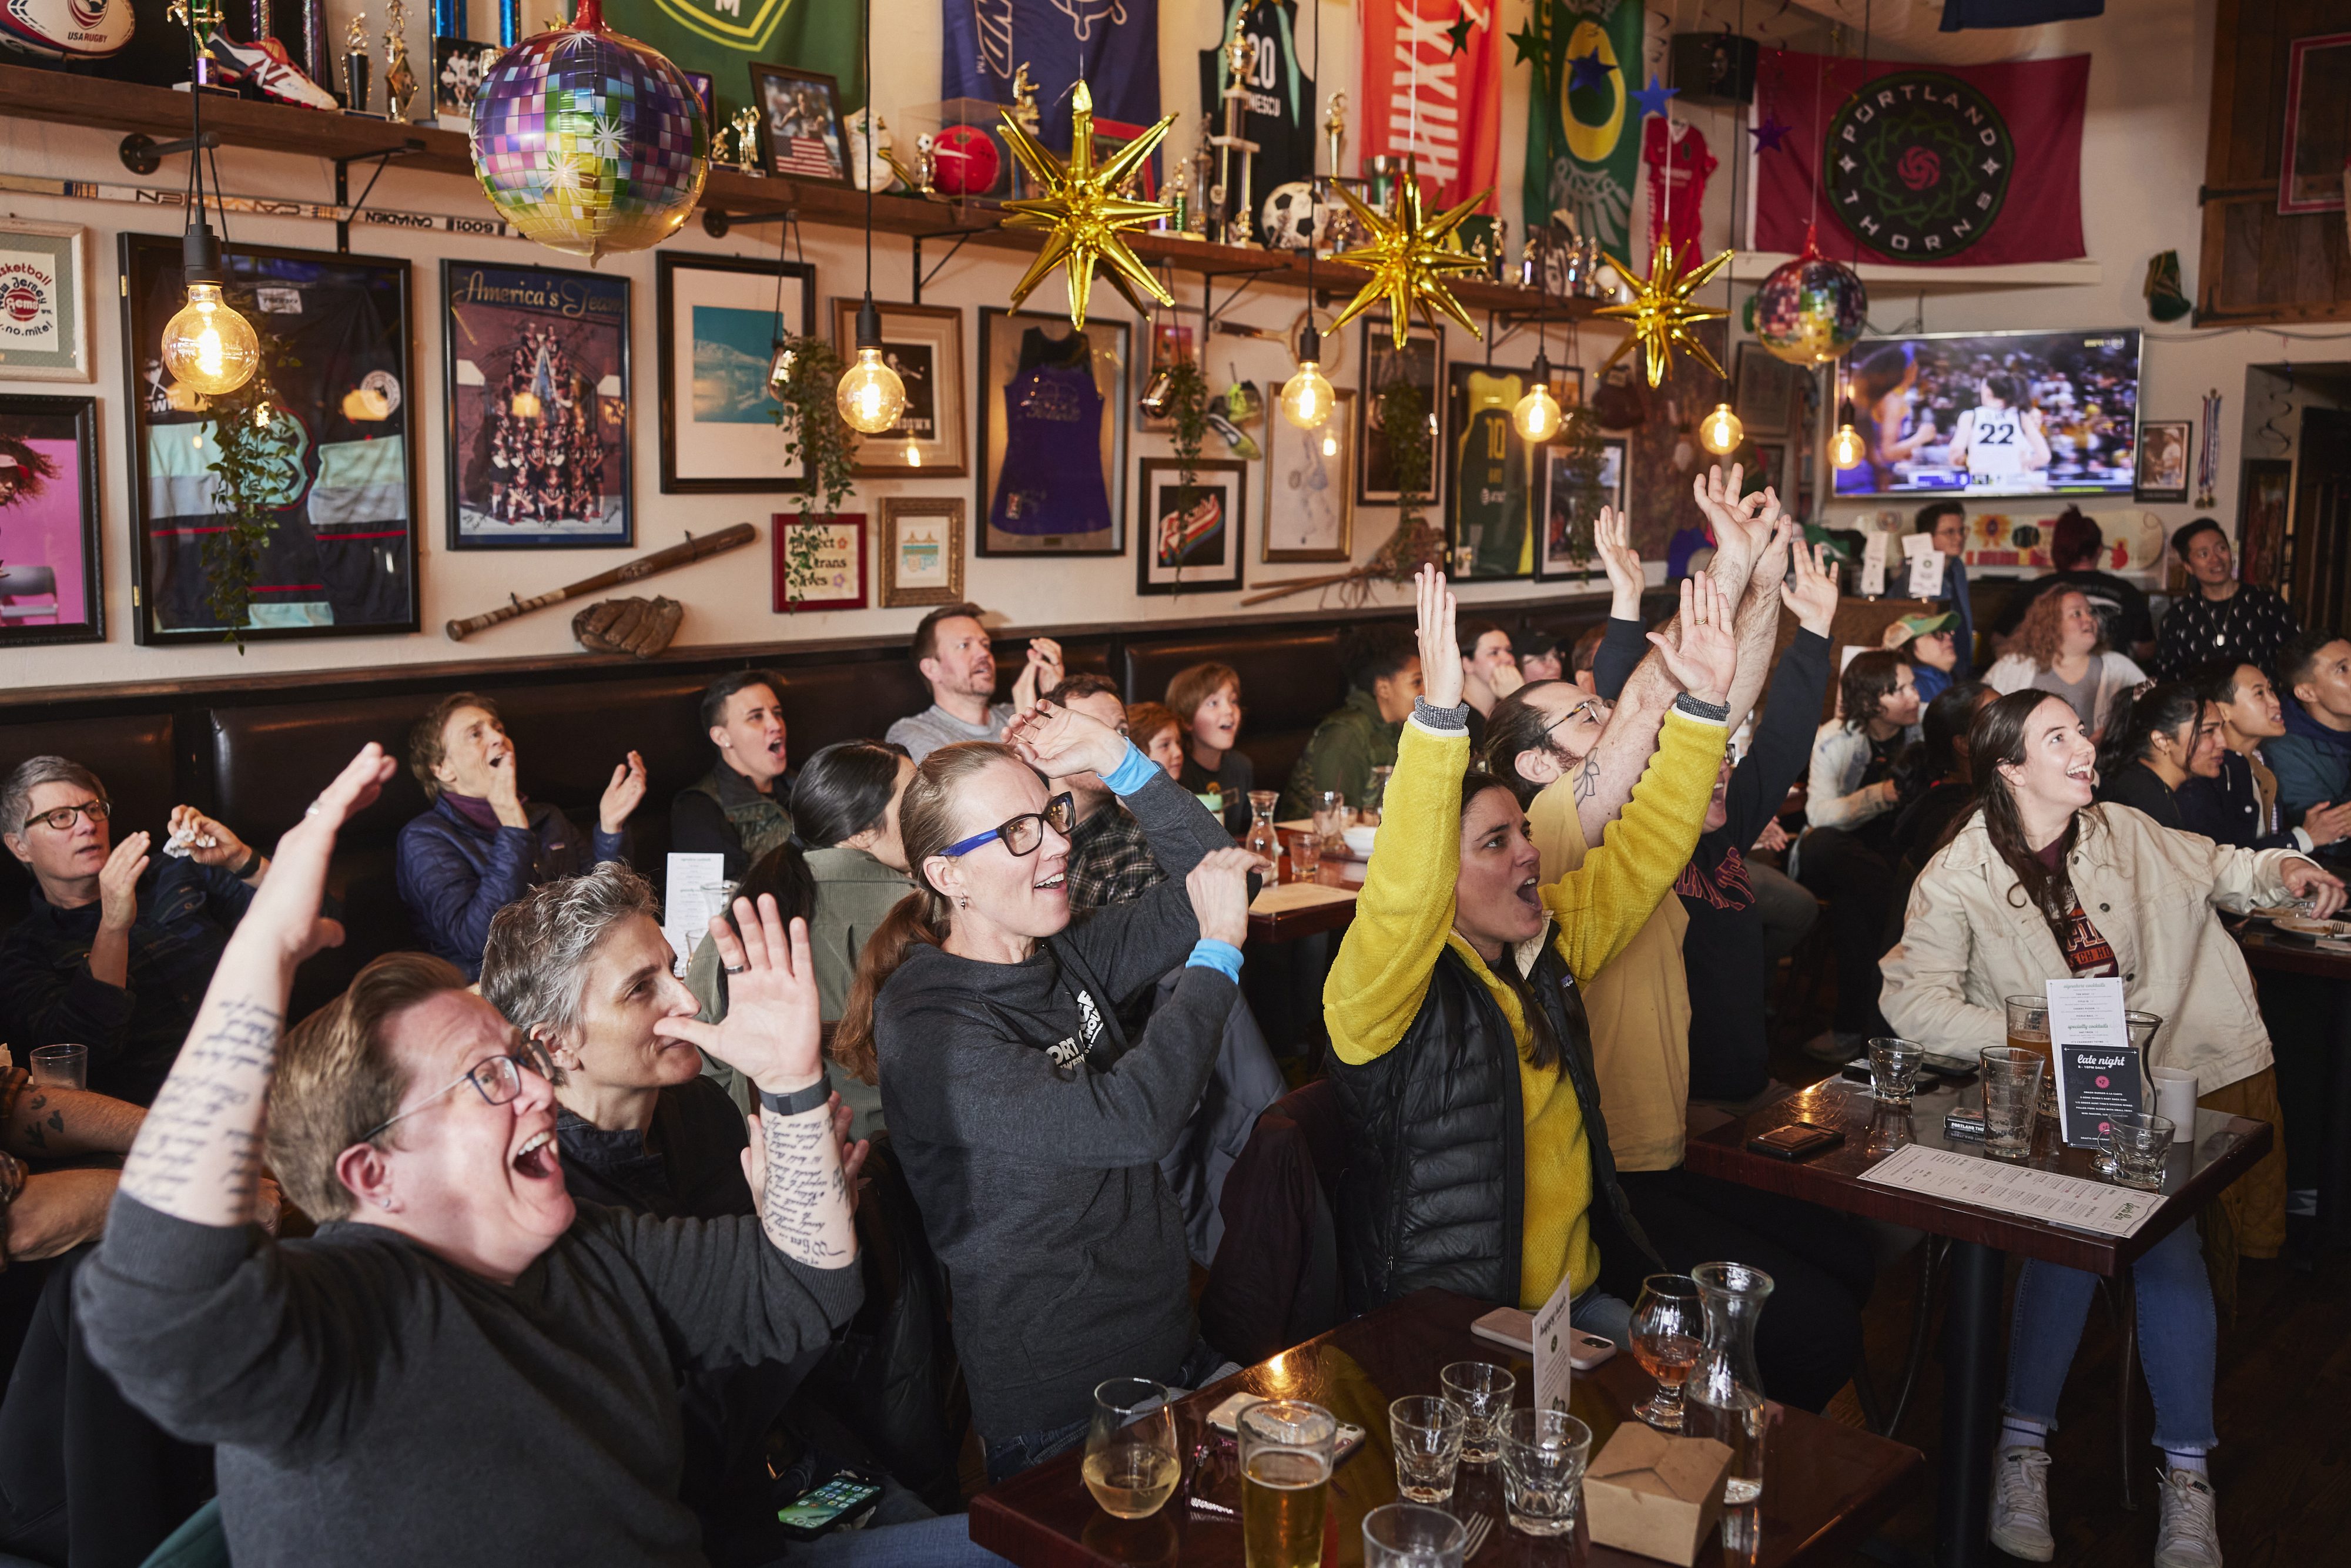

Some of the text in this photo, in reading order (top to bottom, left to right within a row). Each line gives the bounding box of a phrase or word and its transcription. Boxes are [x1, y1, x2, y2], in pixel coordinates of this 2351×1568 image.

[68, 31, 108, 43] USA RUGBY
[1247, 32, 1276, 89] 20
[1841, 84, 1997, 146] PORTLAND
[364, 212, 433, 229] CANADIEN
[1843, 189, 1992, 251] THORNS
[451, 270, 560, 308] America's
[1485, 417, 1506, 460] 10
[1978, 423, 2014, 445] 22
[2077, 1054, 2125, 1068] late night
[1951, 1122, 1975, 1130] PORTLAND
[2192, 1480, 2208, 1493] NIKE
